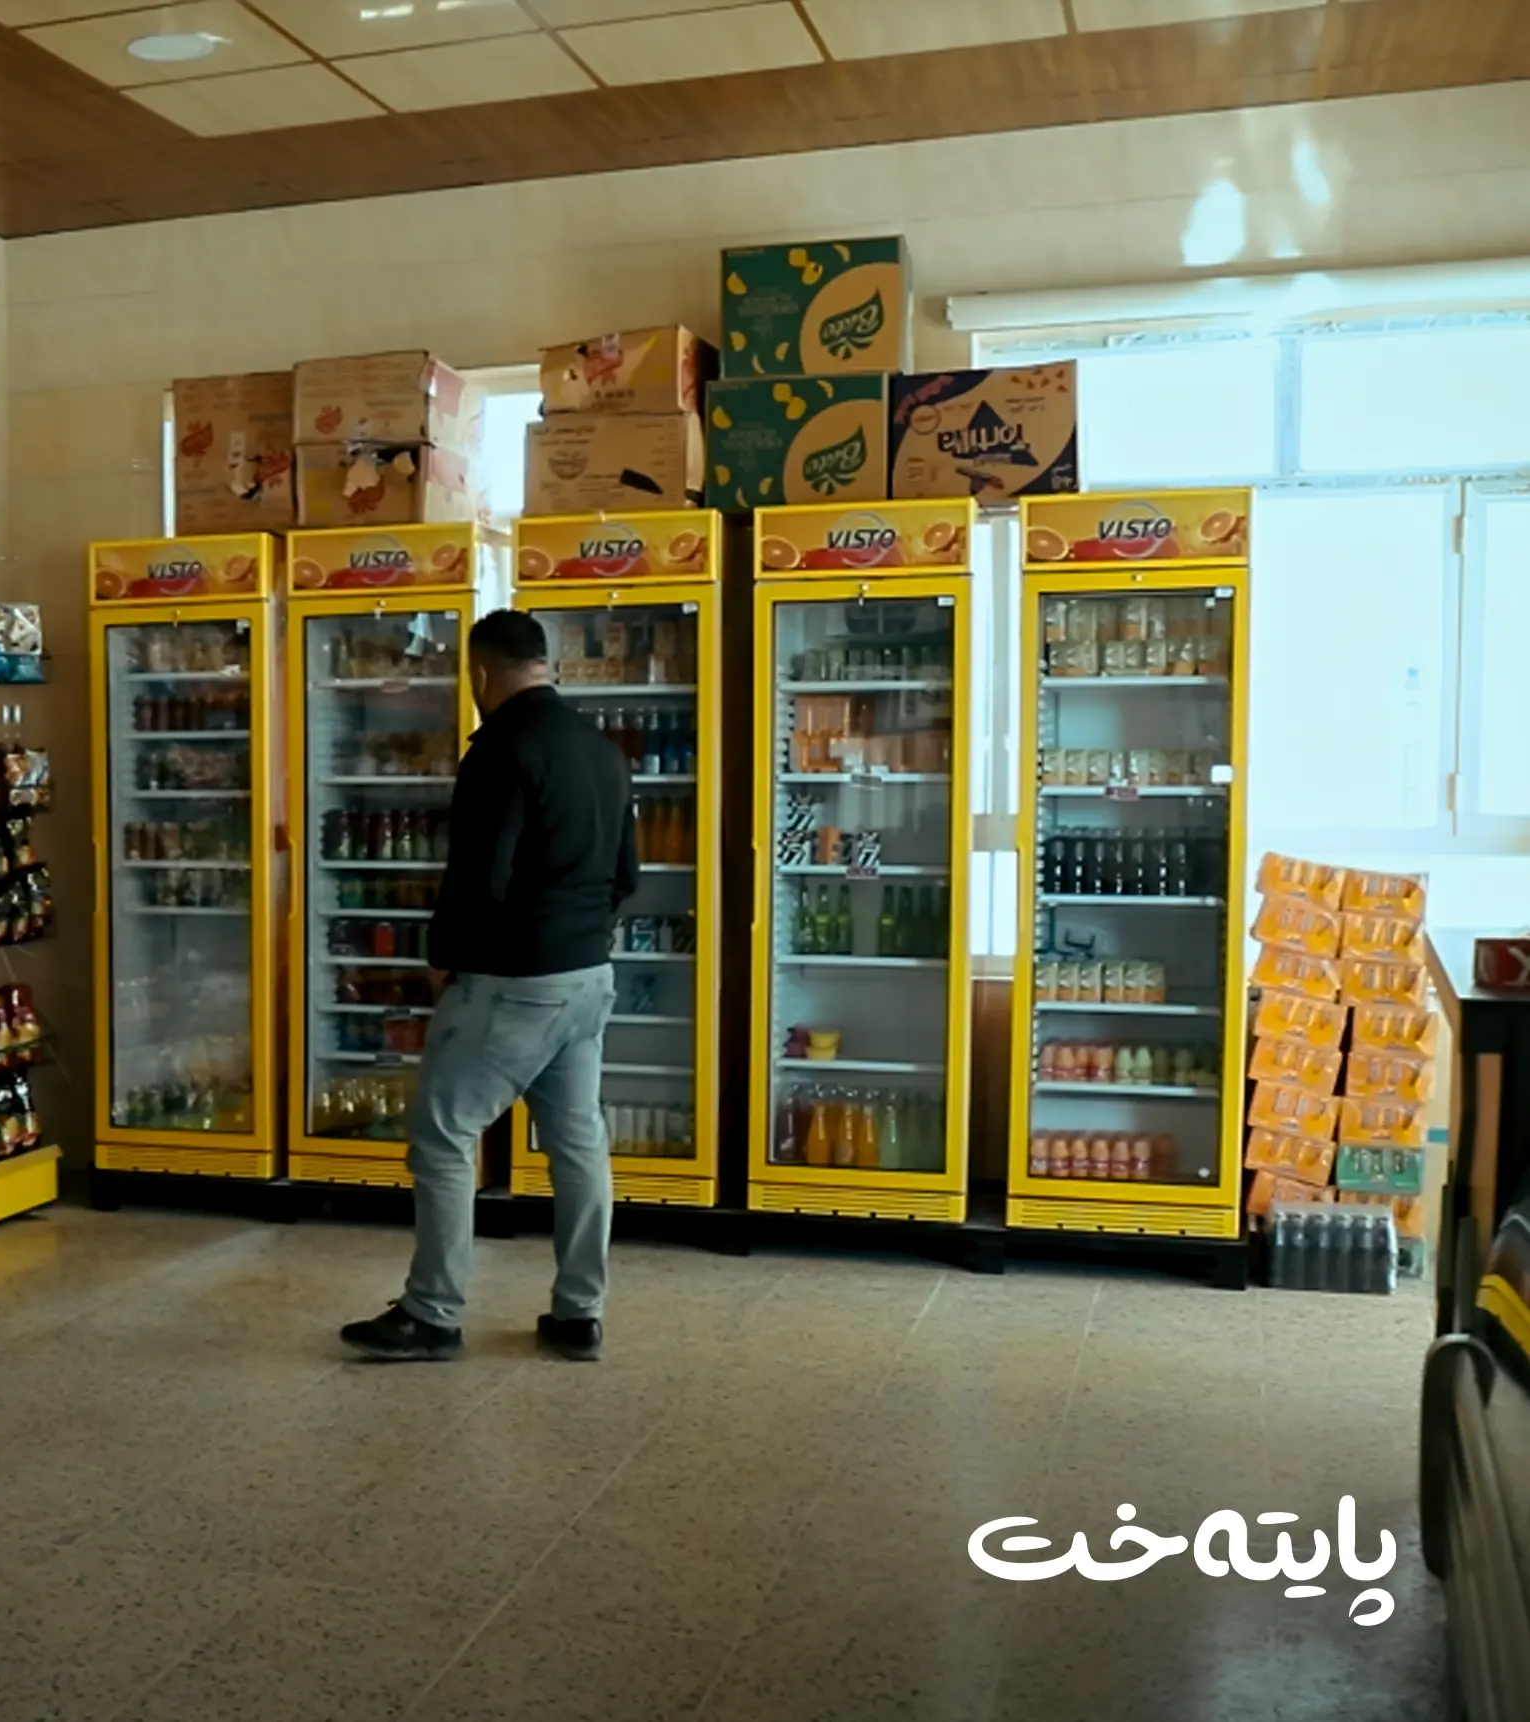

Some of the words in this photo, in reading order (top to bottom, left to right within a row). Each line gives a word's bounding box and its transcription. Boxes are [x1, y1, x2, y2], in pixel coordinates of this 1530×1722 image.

[821, 303, 880, 339] Bato
[937, 424, 1031, 455] Tortilla
[804, 440, 862, 476] Bato
[828, 528, 897, 549] VISTO
[1098, 518, 1173, 541] VISTO
[348, 550, 409, 569] VISTO
[578, 539, 644, 559] VISTO
[147, 561, 203, 581] VISTO
